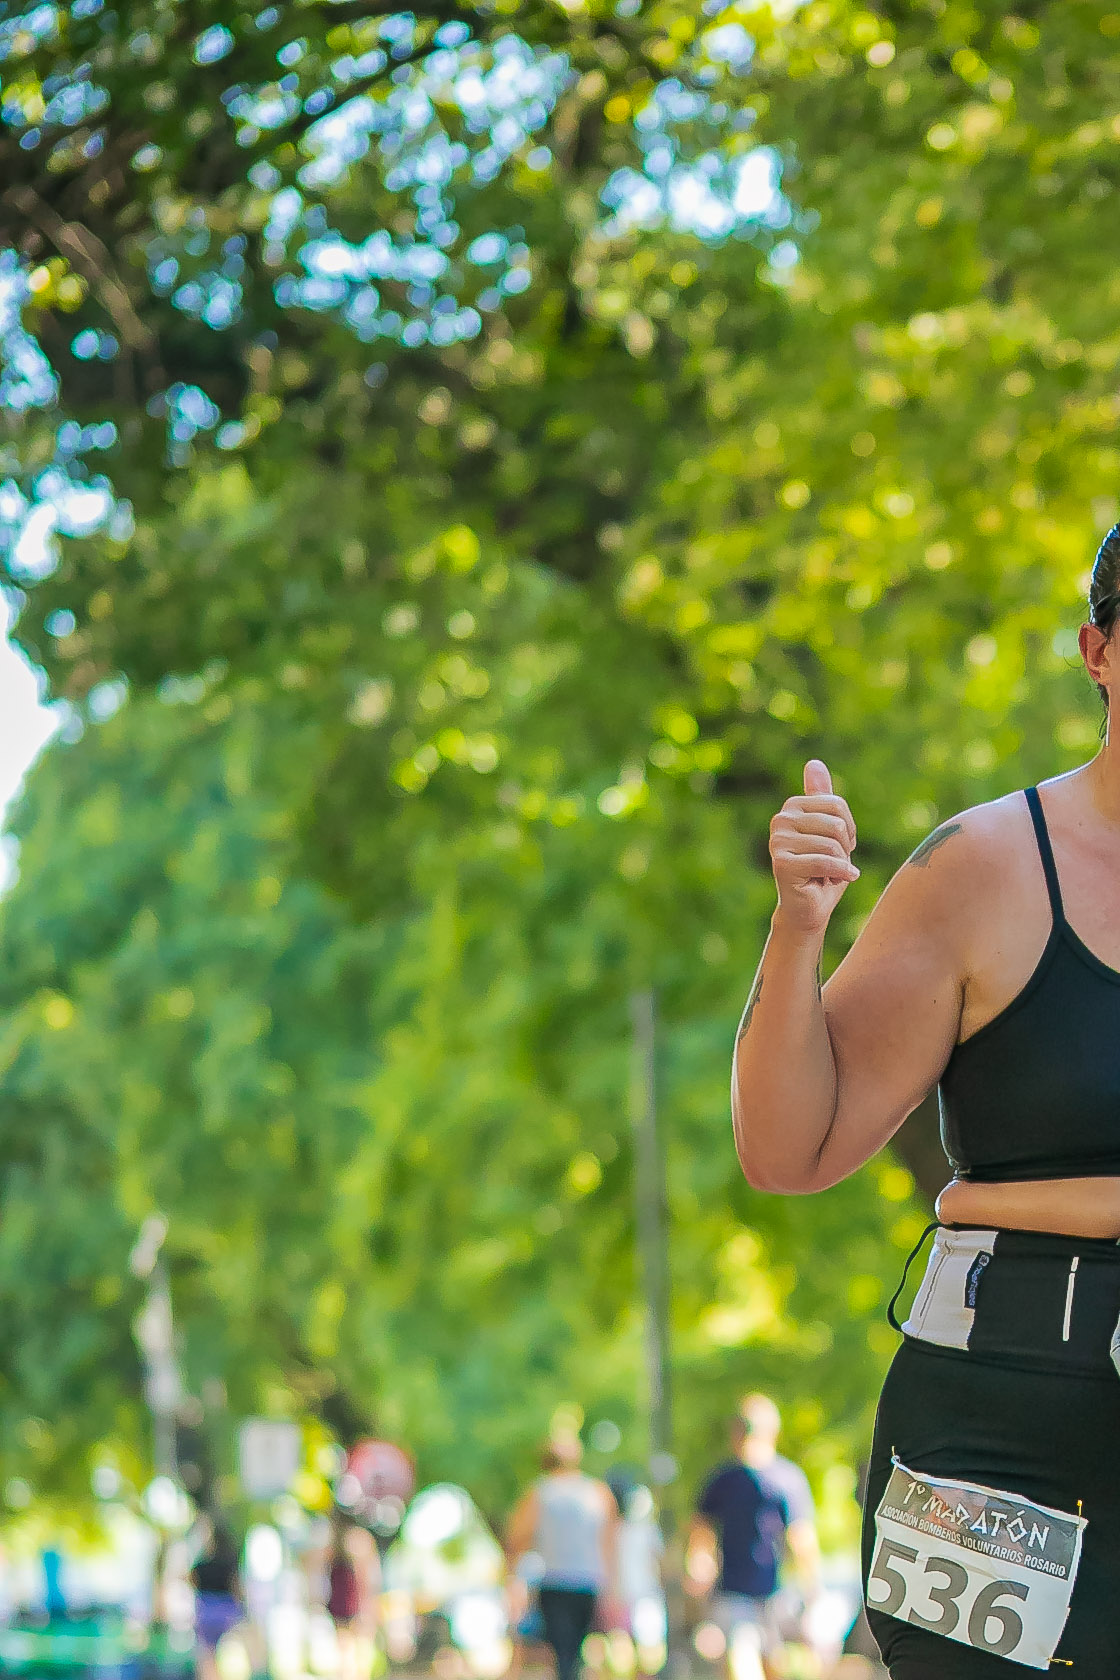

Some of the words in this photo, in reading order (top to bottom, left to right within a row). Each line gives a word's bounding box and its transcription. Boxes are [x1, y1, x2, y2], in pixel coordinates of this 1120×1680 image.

[918, 1519, 961, 1544] BOMBEROS
[962, 1535, 1024, 1563] VOLUNTARIOS
[1023, 1554, 1066, 1577] ROSARIO
[922, 1494, 1050, 1552] MARATÓN
[867, 1537, 1031, 1657] 536
